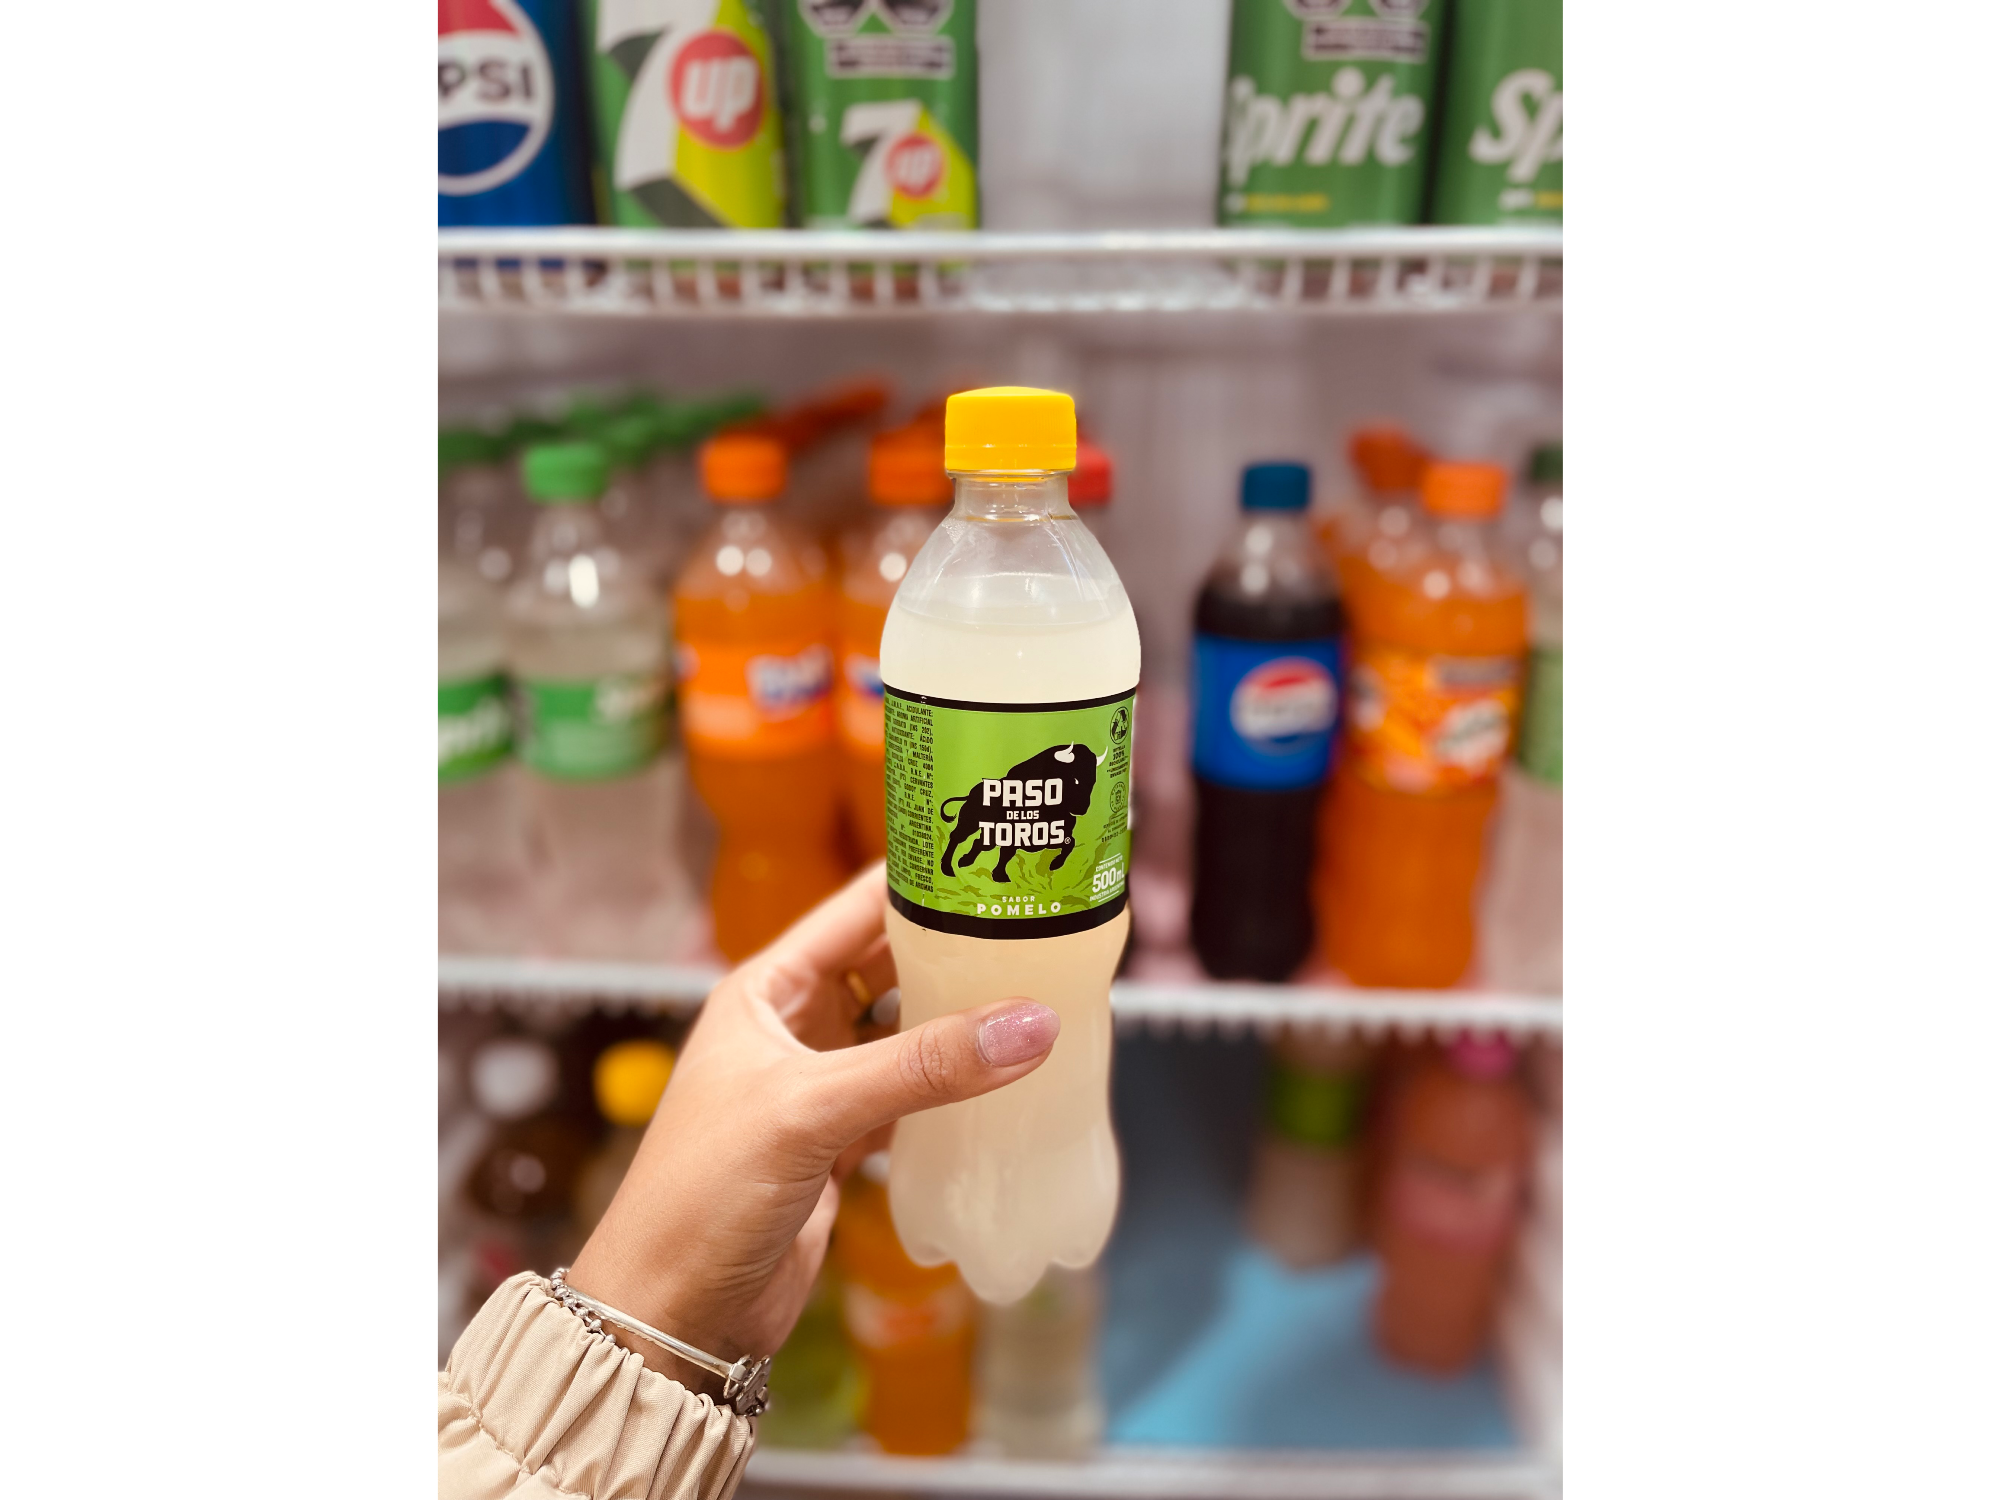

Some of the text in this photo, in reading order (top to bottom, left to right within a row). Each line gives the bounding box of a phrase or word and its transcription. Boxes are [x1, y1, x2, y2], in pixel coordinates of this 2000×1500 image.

[982, 778, 1062, 807] PASO
[1006, 810, 1039, 820] DE LOS
[979, 820, 1064, 846] TOROS
[923, 840, 934, 849] LOTE
[977, 902, 1061, 916] POMELO
